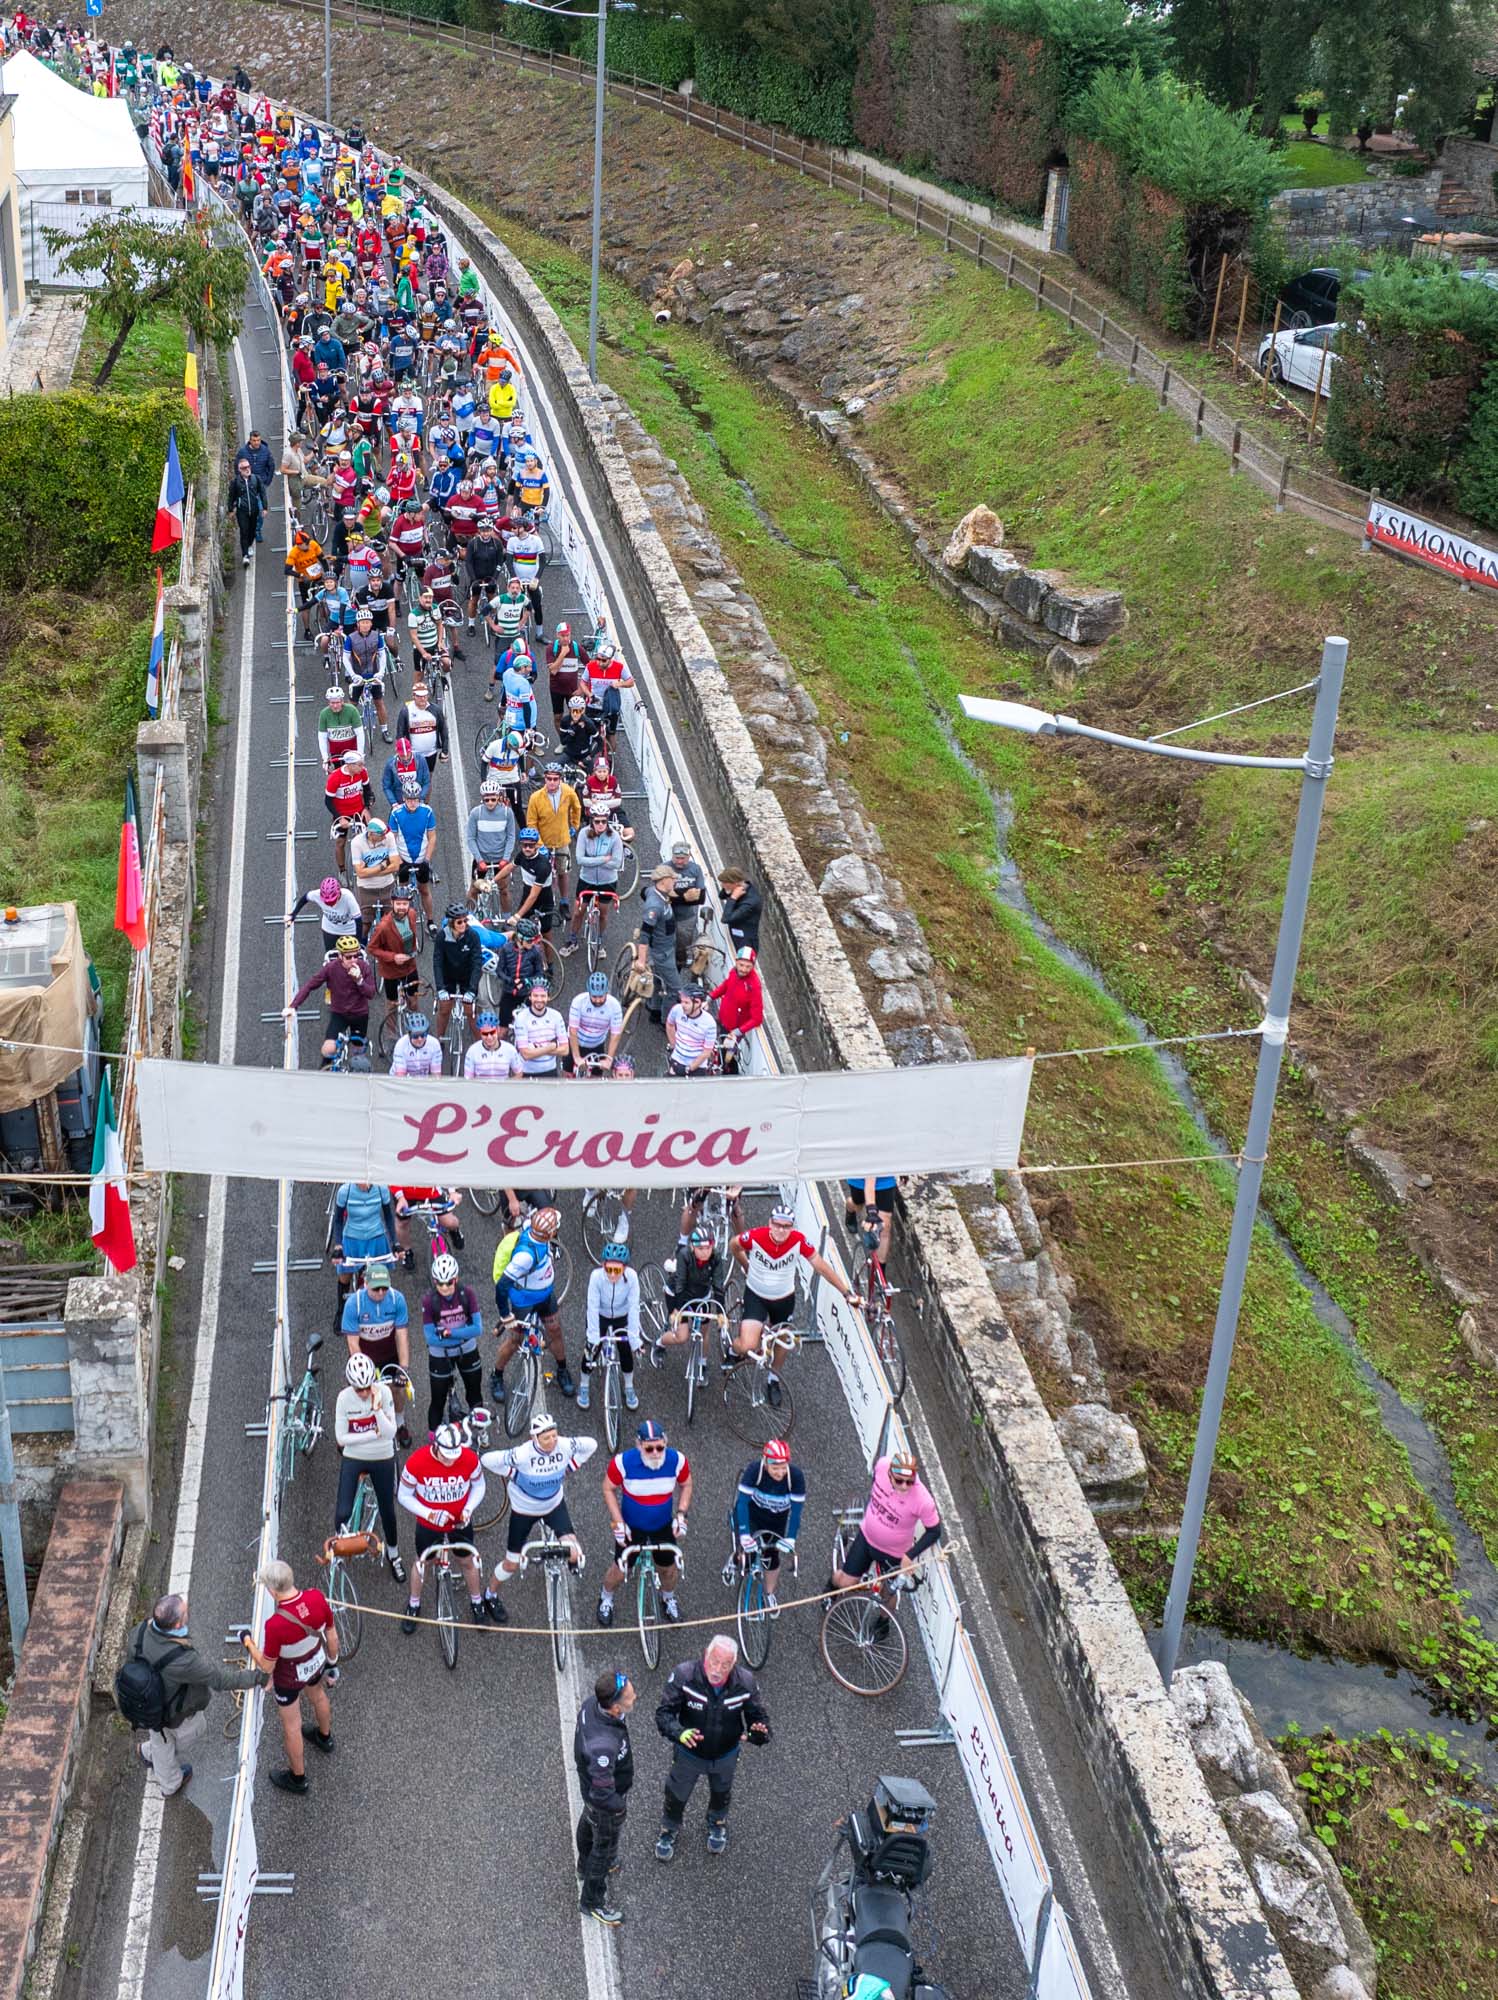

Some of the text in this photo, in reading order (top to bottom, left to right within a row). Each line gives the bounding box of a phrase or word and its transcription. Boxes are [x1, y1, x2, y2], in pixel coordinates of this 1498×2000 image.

[754, 1250, 795, 1271] FAEMINO
[530, 1452, 564, 1468] FORD
[423, 1475, 465, 1486] VELDA
